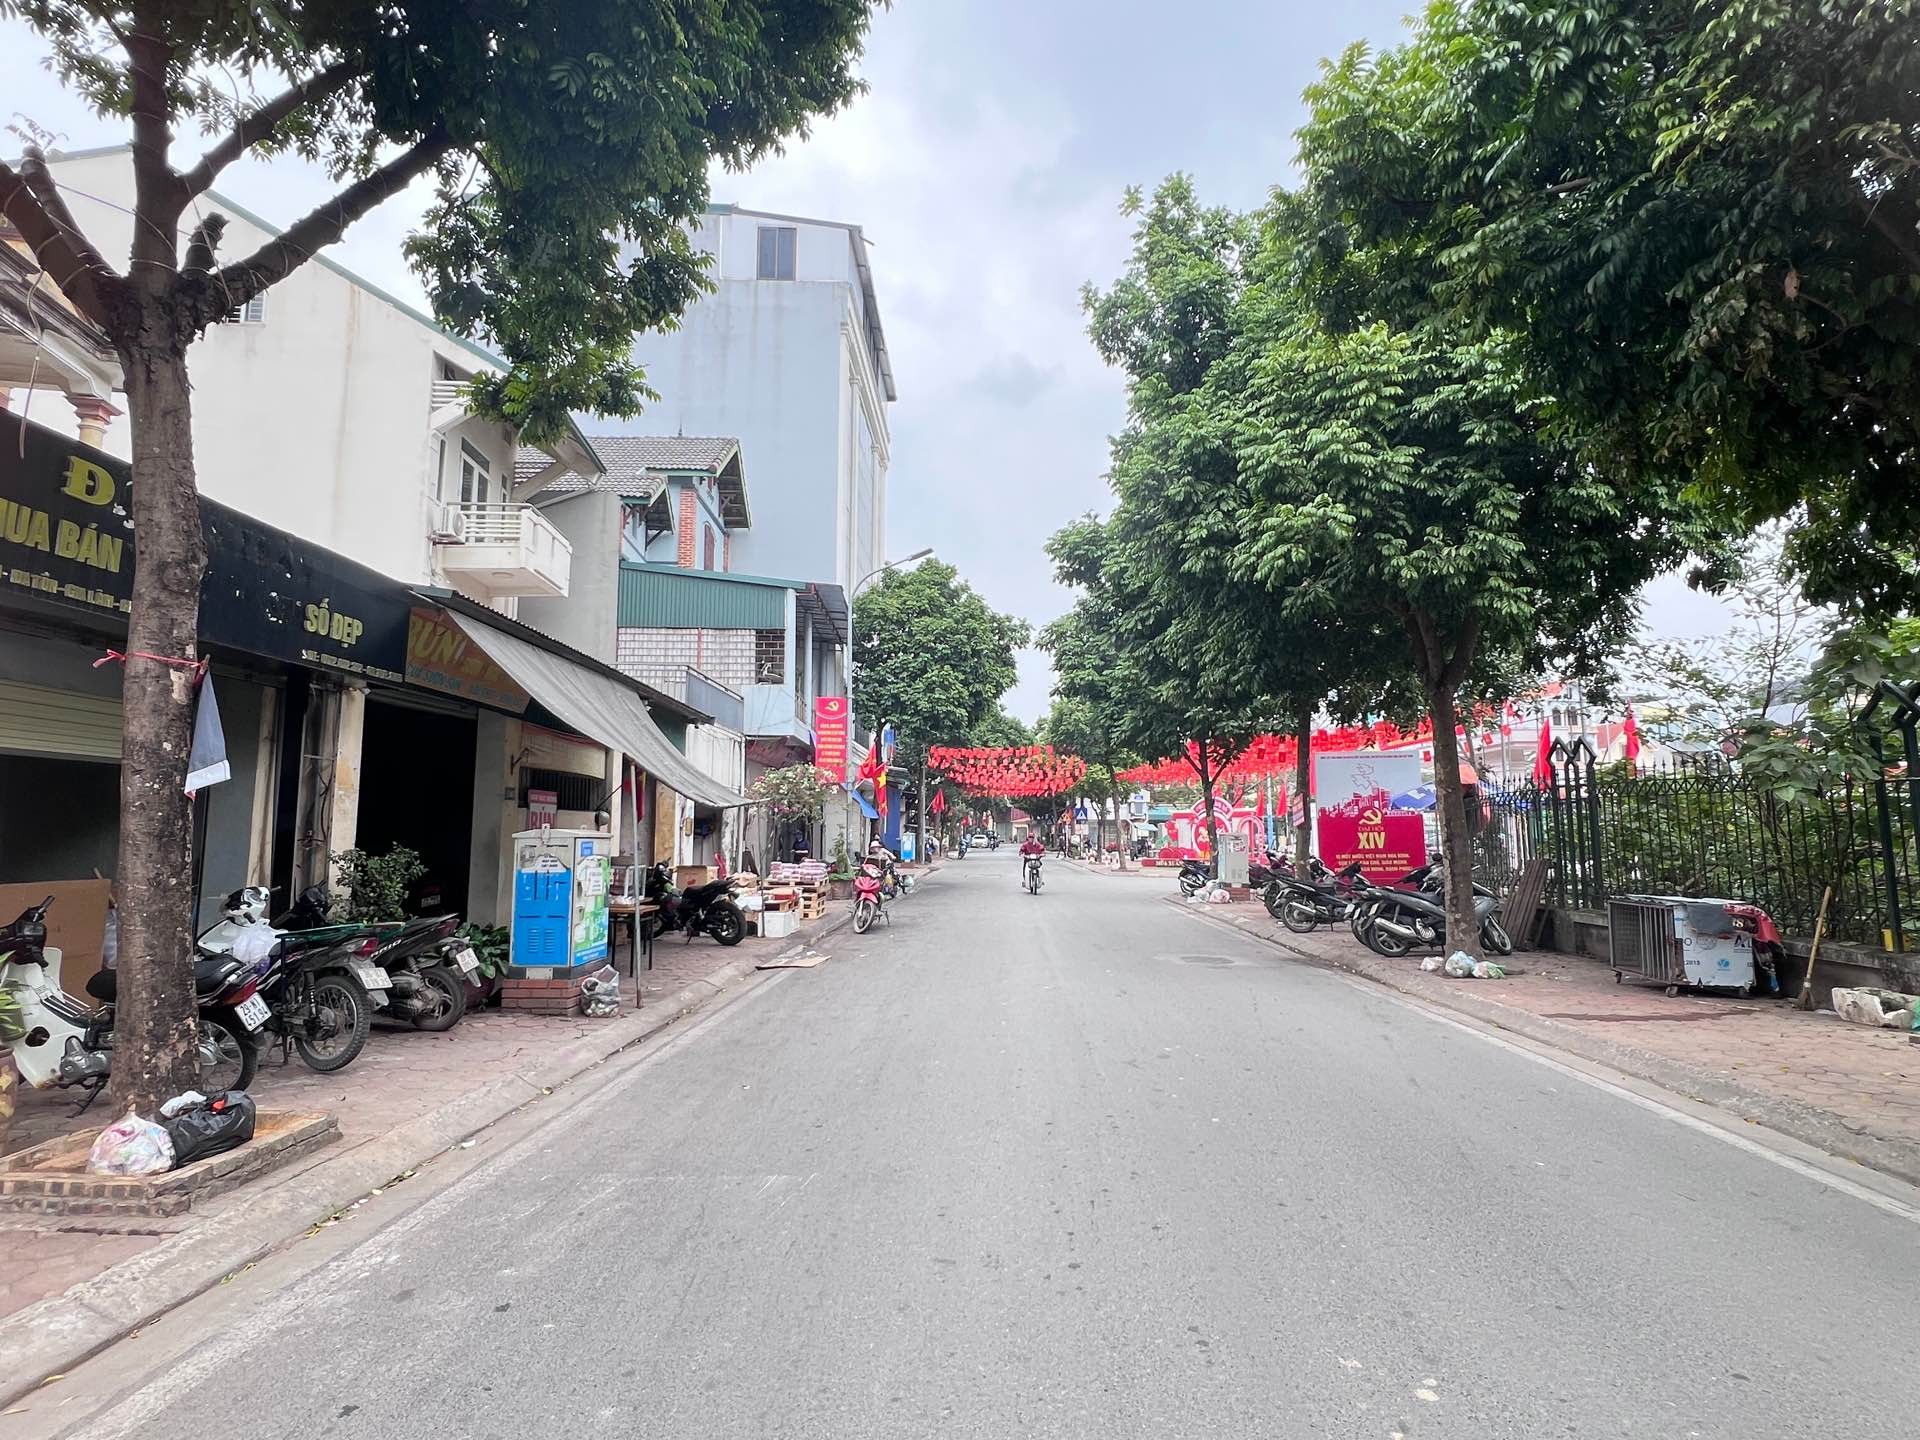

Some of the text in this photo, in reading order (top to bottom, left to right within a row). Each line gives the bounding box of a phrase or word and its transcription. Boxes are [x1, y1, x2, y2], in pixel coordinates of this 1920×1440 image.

[54, 519, 123, 573] BÁN
[304, 598, 363, 648] SỐ ĐẸP
[1357, 831, 1385, 849] XIV
